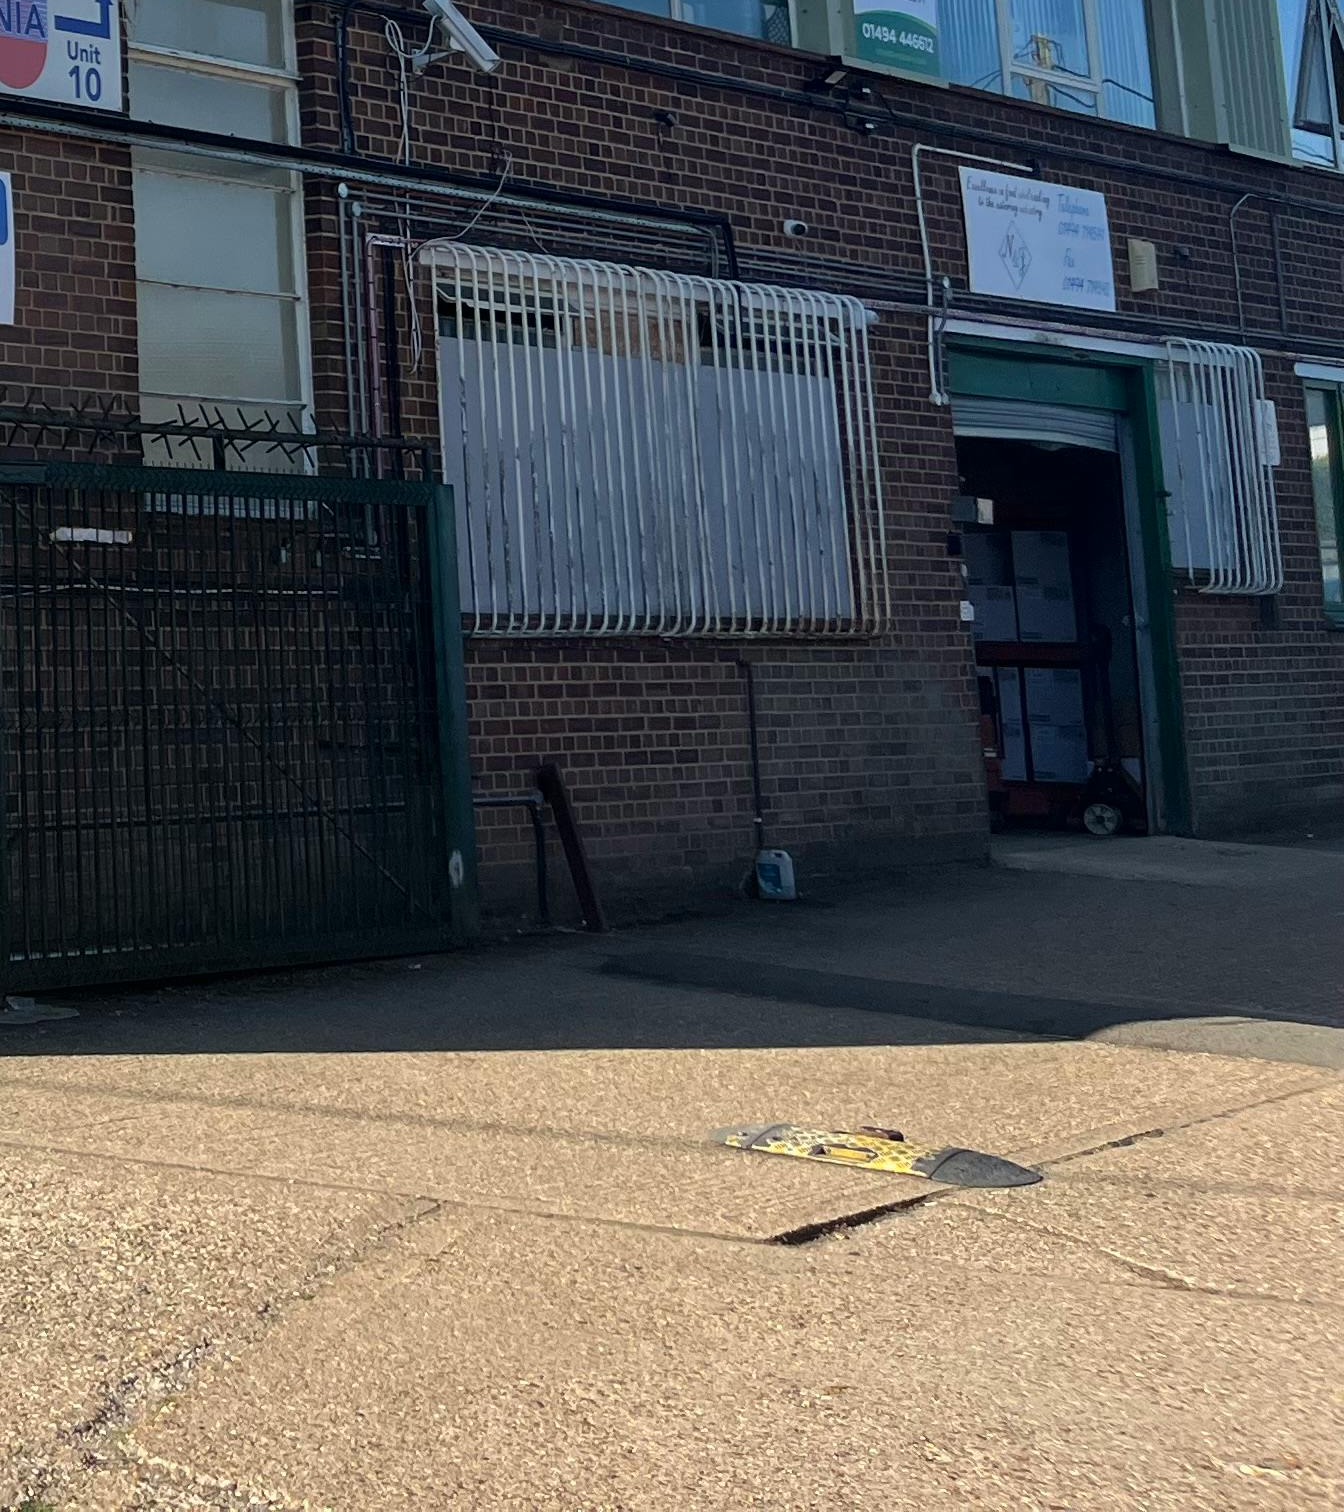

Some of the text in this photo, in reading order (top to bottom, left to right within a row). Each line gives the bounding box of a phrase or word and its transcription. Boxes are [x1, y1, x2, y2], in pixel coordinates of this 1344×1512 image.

[863, 22, 896, 45] 01494
[67, 40, 100, 65] Unit
[69, 65, 101, 102] 10
